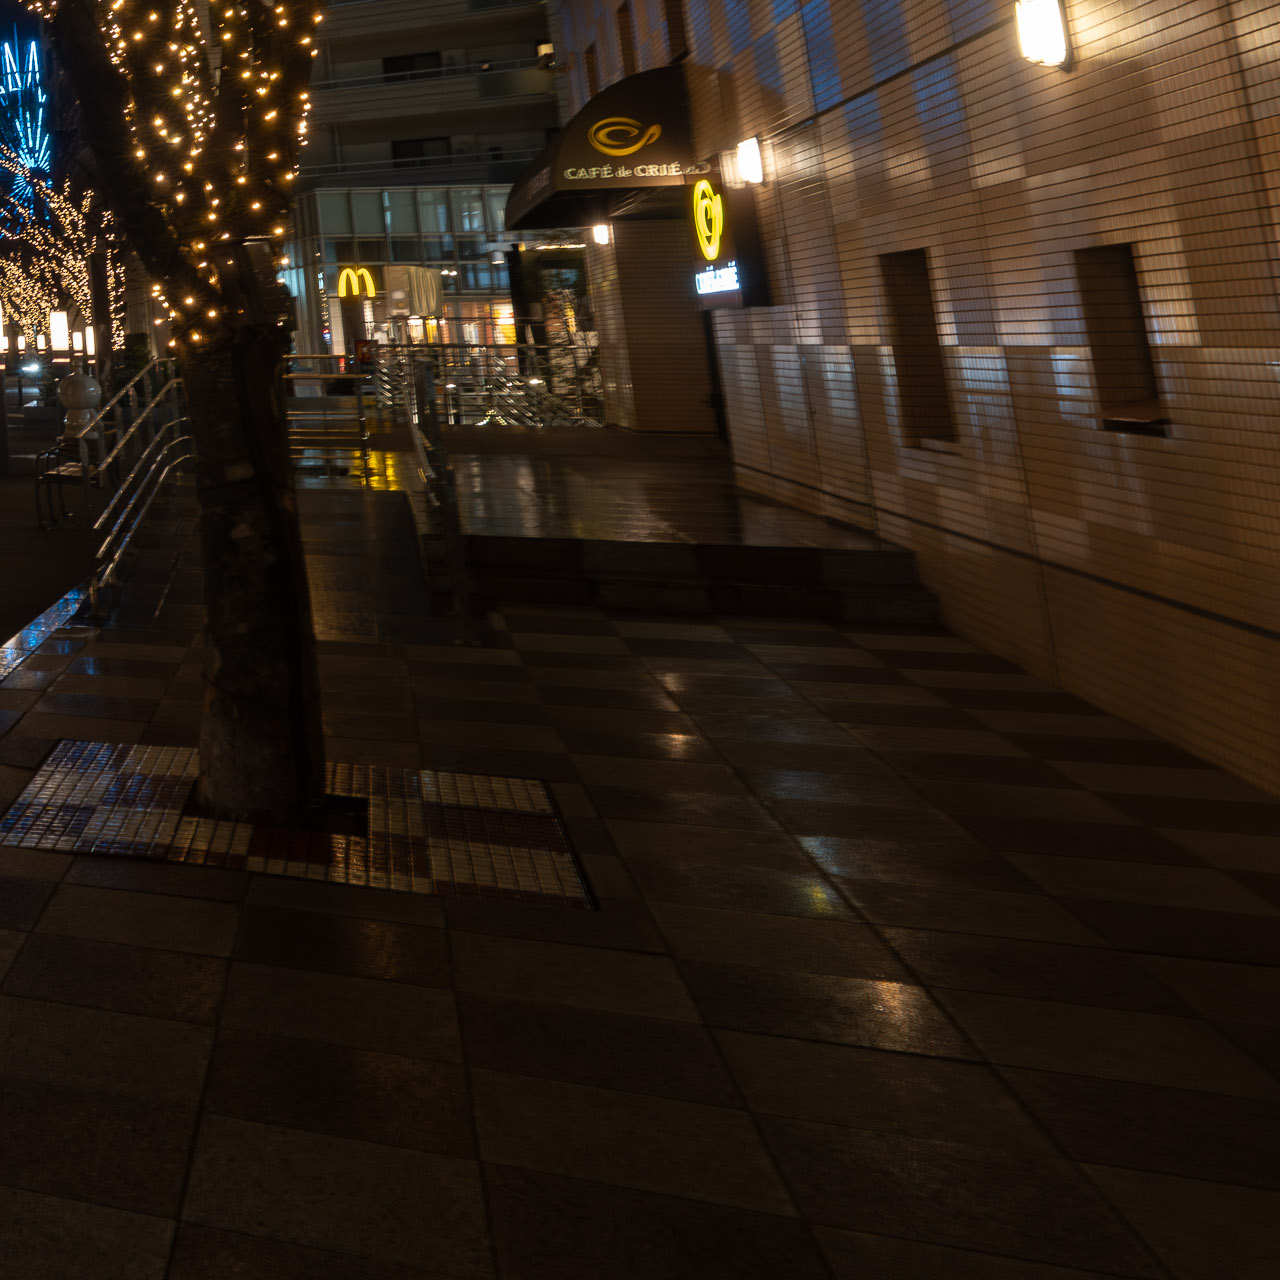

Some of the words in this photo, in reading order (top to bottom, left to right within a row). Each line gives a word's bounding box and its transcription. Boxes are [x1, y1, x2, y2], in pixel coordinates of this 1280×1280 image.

[563, 163, 614, 180] CAFÉ
[615, 165, 633, 178] de
[633, 160, 682, 177] CRIÉ
